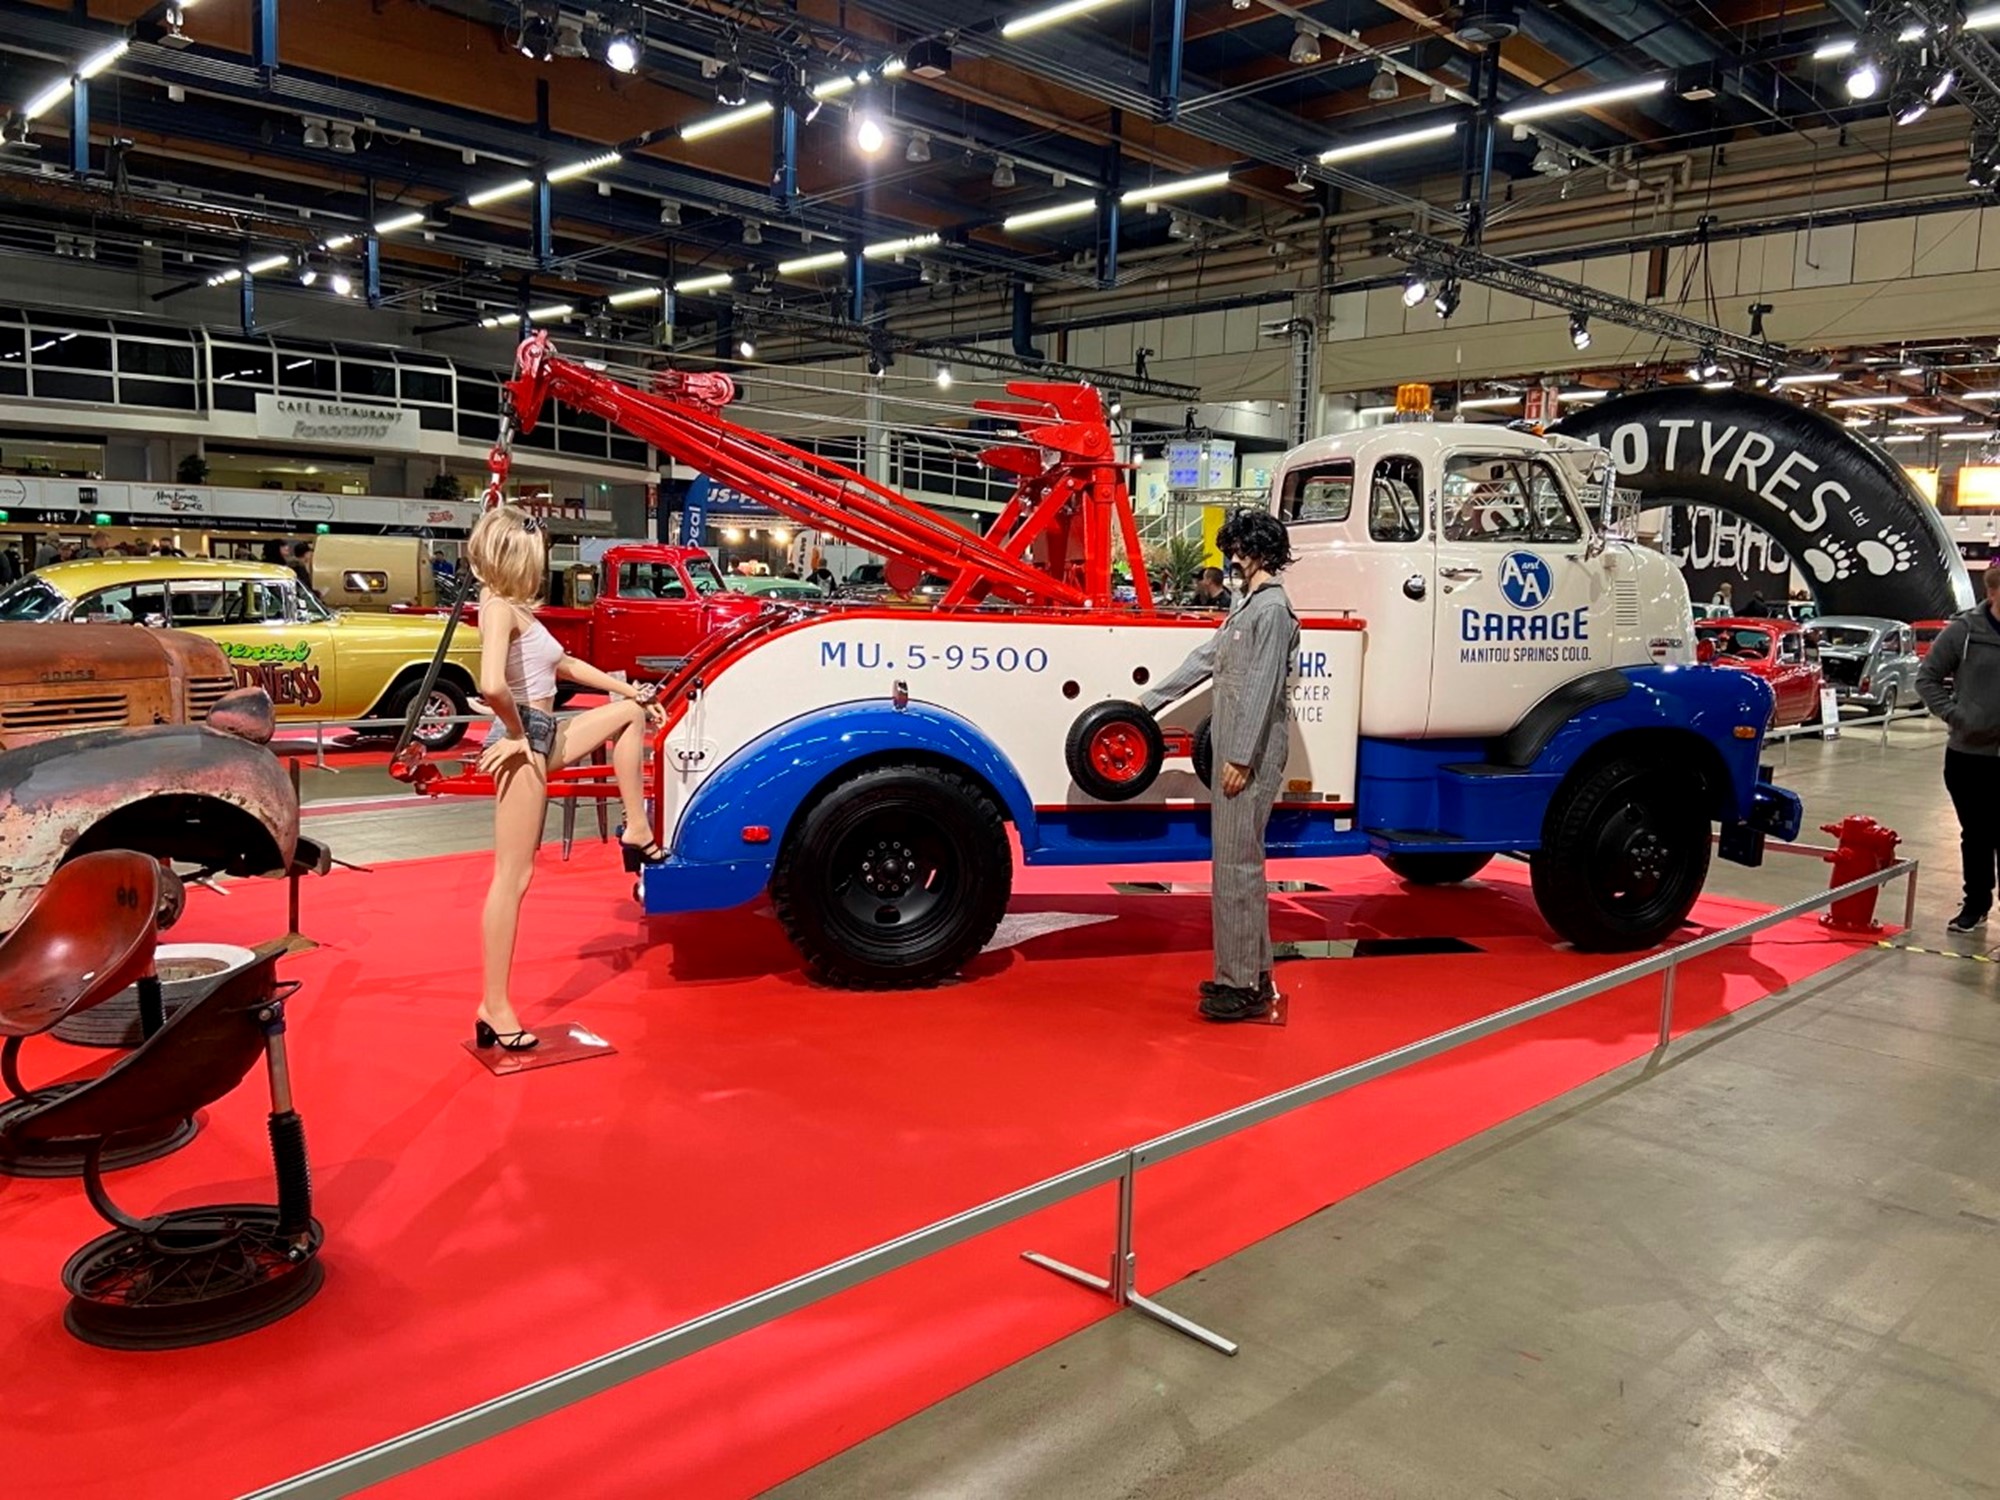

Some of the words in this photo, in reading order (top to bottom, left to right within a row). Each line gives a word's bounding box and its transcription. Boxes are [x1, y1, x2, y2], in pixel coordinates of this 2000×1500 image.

[277, 401, 311, 414] CAFÉ
[318, 405, 403, 423] RESTAURANT
[1848, 506, 1870, 528] Ltd
[1502, 557, 1525, 586] A
[1521, 558, 1541, 570] and
[1520, 573, 1544, 602] A
[1462, 606, 1589, 641] GARAGE
[221, 641, 311, 662] ental
[821, 642, 894, 669] MU.
[907, 645, 1048, 672] 5-9500
[1460, 648, 1510, 663] MANITOU
[1513, 647, 1559, 662] SPRINGS
[1562, 646, 1592, 661] COLO.
[1299, 652, 1332, 677] HR.
[231, 662, 322, 707] DNESS
[1286, 685, 1330, 701] ECKER
[1286, 706, 1323, 722] RVICE
